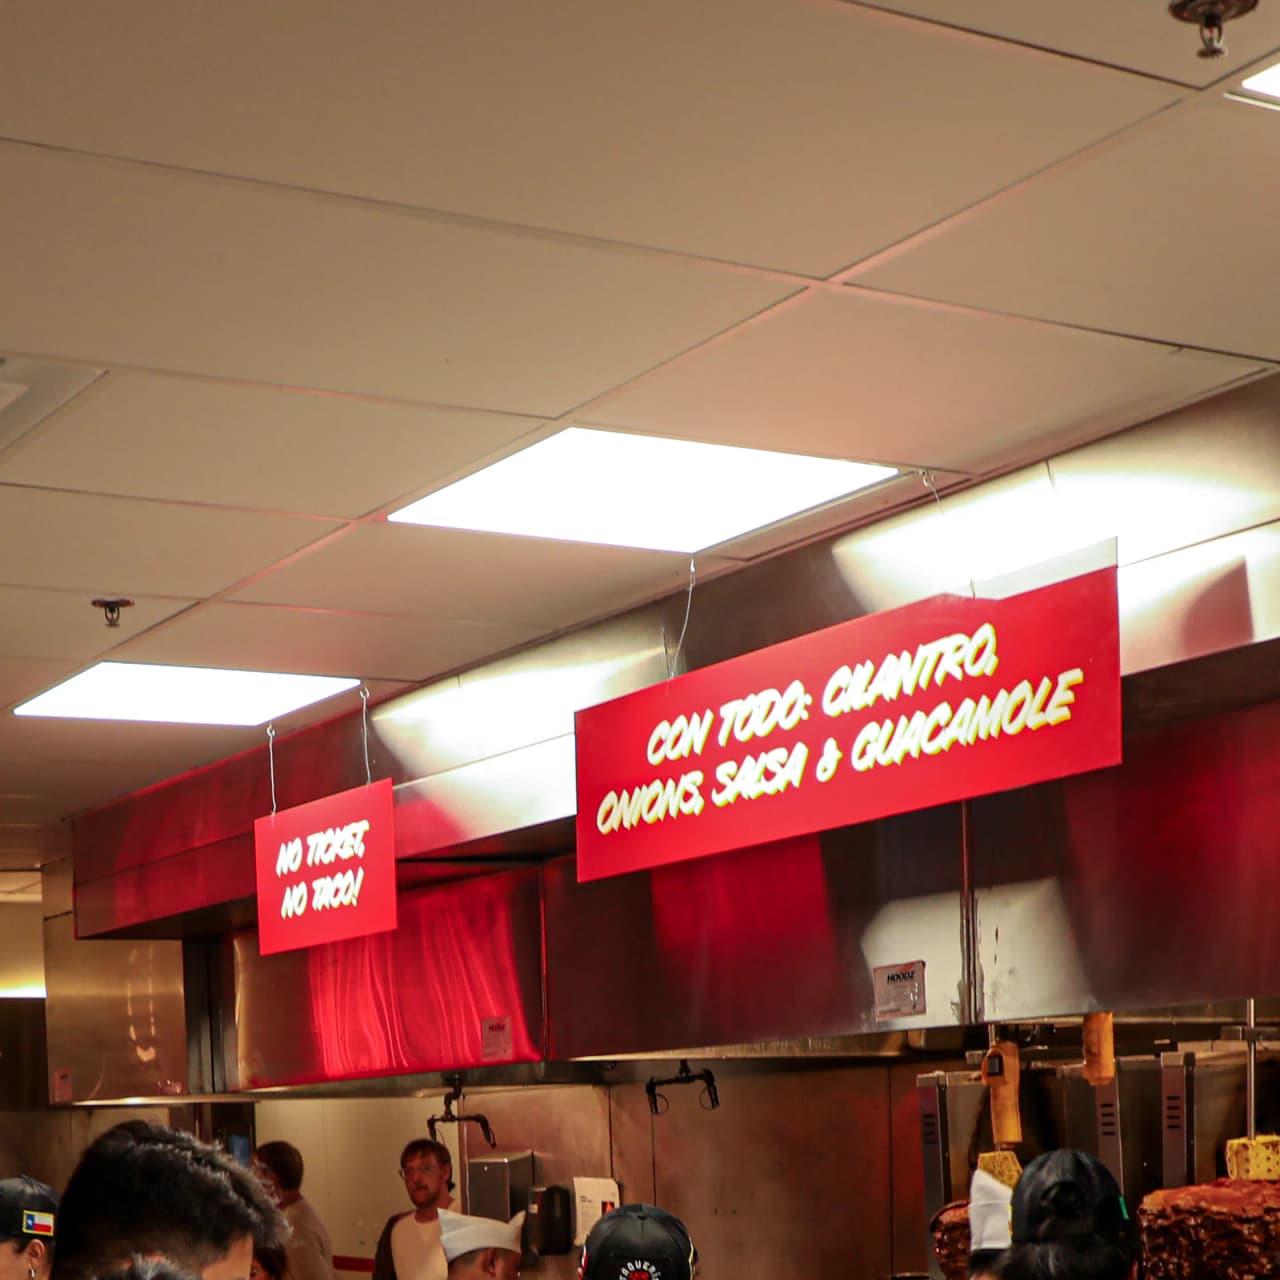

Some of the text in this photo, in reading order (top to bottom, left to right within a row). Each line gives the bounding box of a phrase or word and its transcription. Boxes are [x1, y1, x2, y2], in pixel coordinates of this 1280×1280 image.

[646, 708, 713, 766] CON
[718, 680, 812, 748] TODO:
[711, 741, 808, 807] SALSA
[816, 737, 842, 783] &
[851, 668, 1084, 772] GUACAMOLE
[276, 837, 303, 878] NO
[281, 866, 364, 920] NO TACO!
